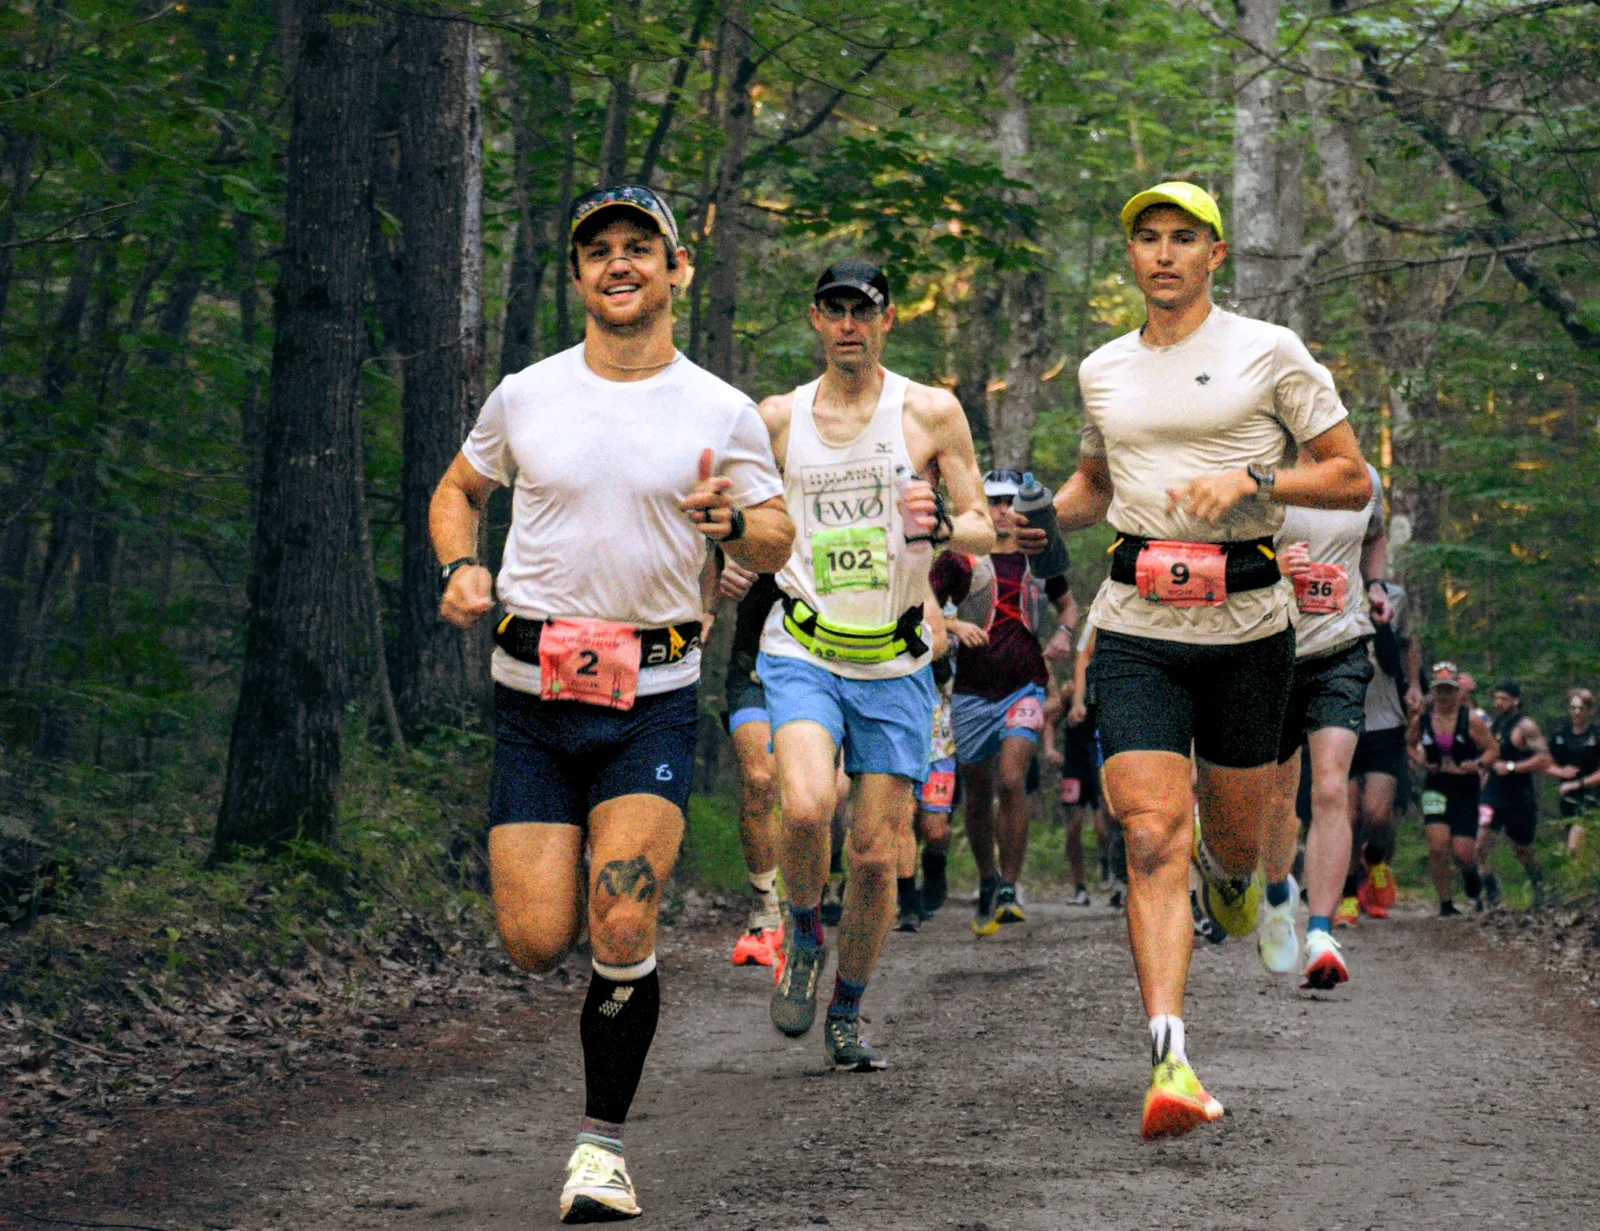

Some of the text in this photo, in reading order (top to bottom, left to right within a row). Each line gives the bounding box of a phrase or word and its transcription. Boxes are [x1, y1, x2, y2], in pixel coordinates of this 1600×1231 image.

[826, 549, 873, 571] 102
[1170, 562, 1190, 585] 9
[1307, 580, 1332, 597] 36
[576, 650, 599, 676] 2
